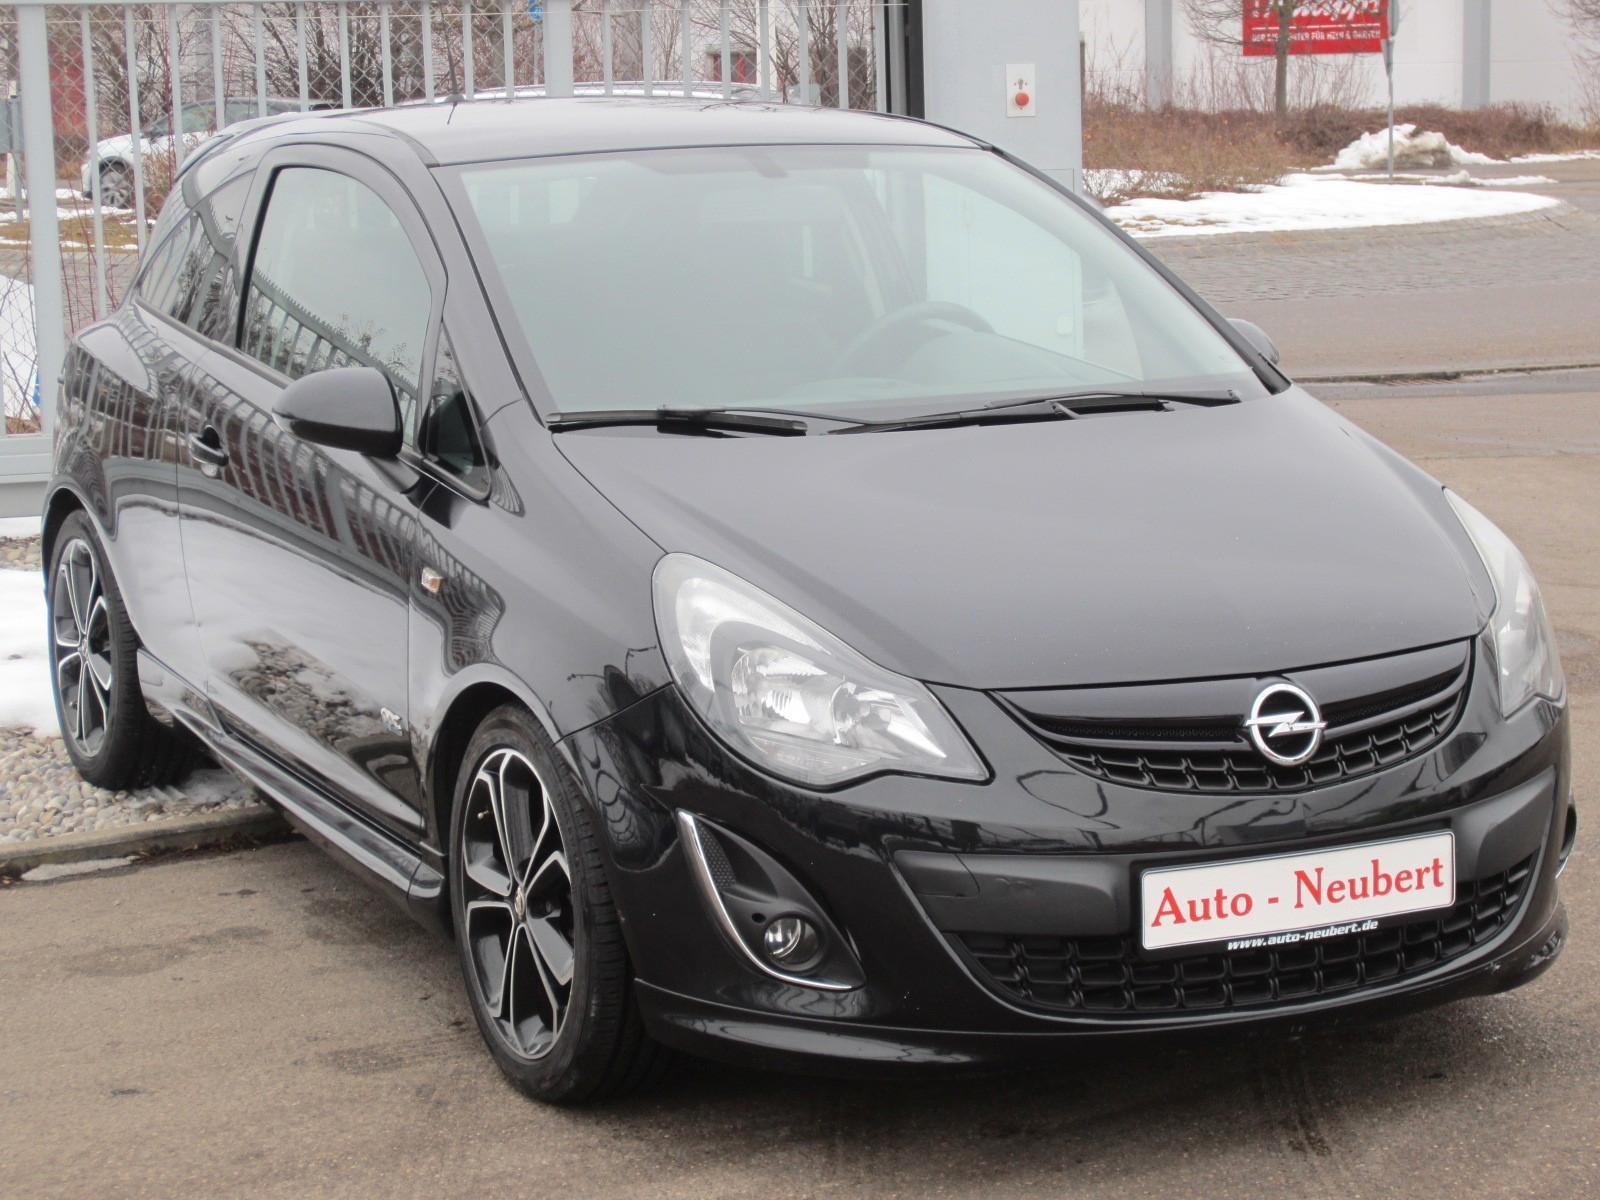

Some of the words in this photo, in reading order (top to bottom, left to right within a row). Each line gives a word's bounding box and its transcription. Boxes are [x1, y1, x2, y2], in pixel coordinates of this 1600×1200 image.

[1311, 31, 1325, 41] FÜR
[1151, 886, 1253, 928] Auto
[1267, 896, 1280, 904] -
[1294, 857, 1444, 910] Neubert
[1227, 919, 1379, 951] www.auto-neubert.de
